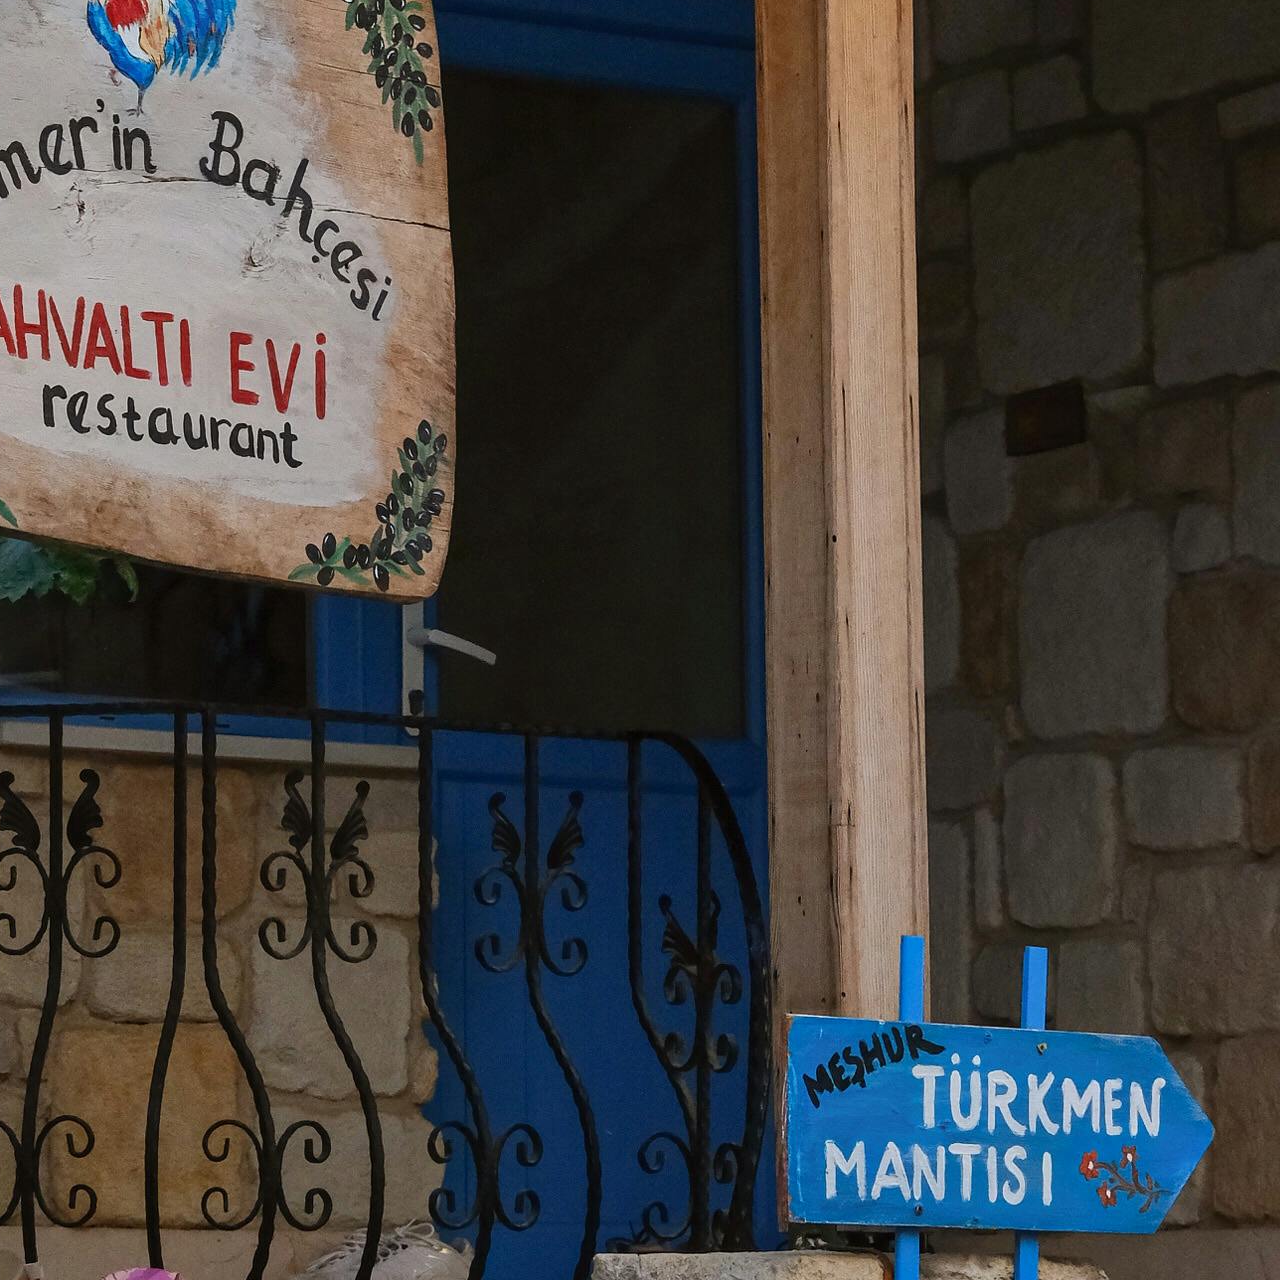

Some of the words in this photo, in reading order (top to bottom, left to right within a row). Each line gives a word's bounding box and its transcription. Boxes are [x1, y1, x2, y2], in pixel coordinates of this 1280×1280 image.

[200, 111, 392, 321] Bahçesi
[43, 383, 302, 467] restaurant
[803, 1025, 946, 1109] MEŞHUR
[912, 1053, 1166, 1137] TÜRKMEN
[825, 1140, 1052, 1206] MANTISI
